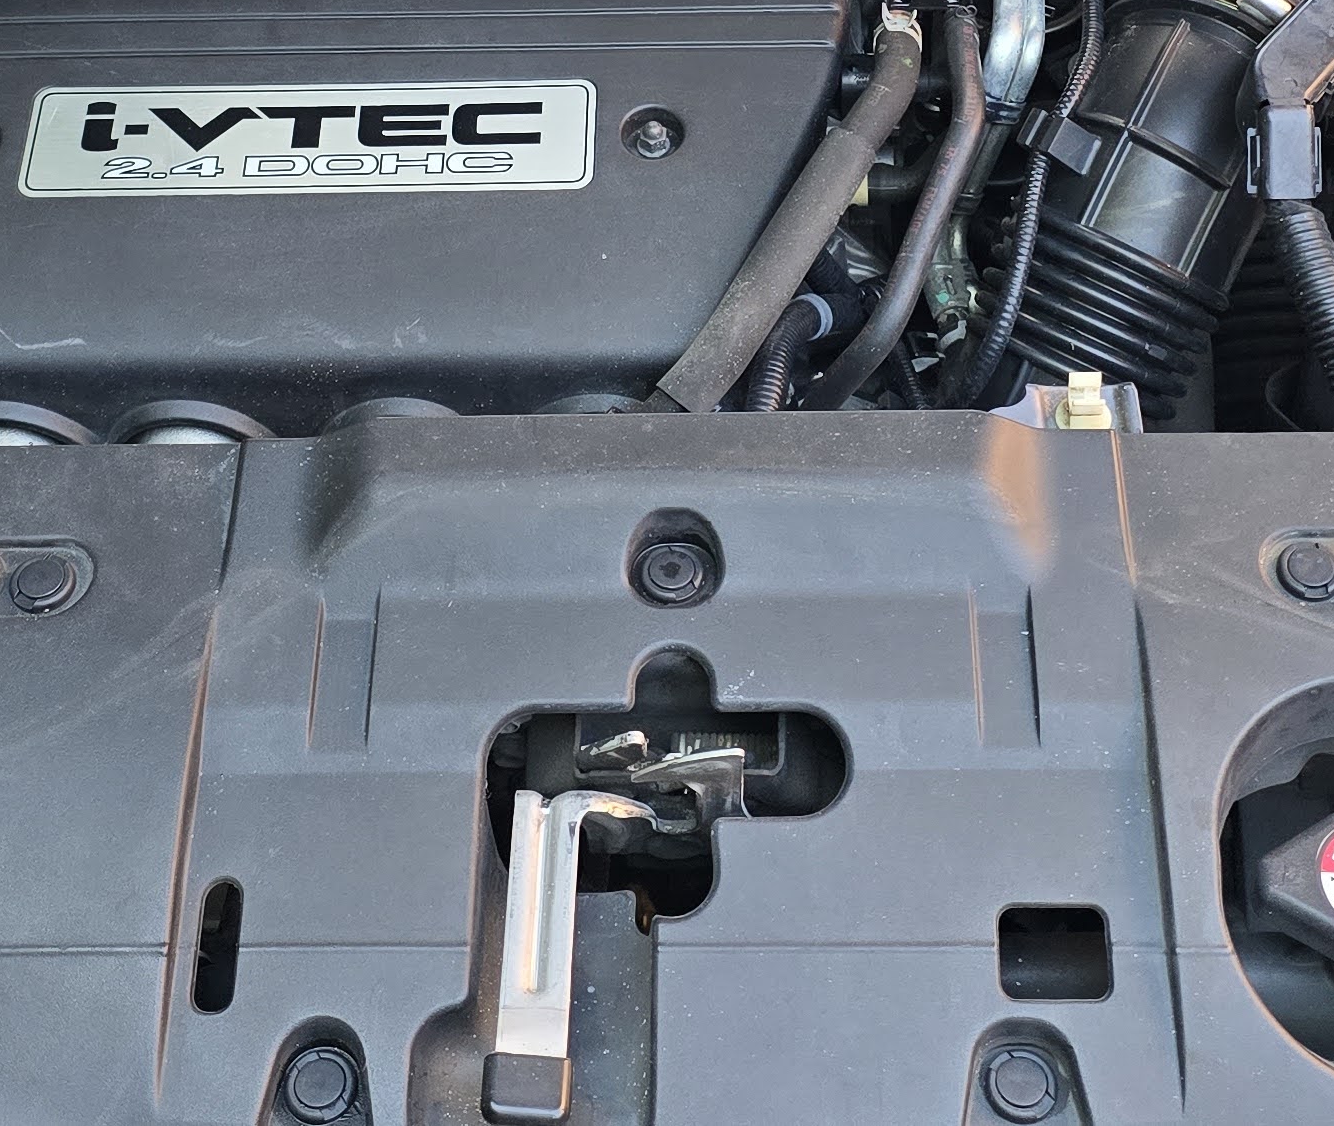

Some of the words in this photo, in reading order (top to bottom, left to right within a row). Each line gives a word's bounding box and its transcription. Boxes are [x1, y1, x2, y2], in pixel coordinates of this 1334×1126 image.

[80, 100, 544, 152] i-VTEC
[99, 155, 225, 180] 2.4
[241, 151, 514, 177] DOHC
